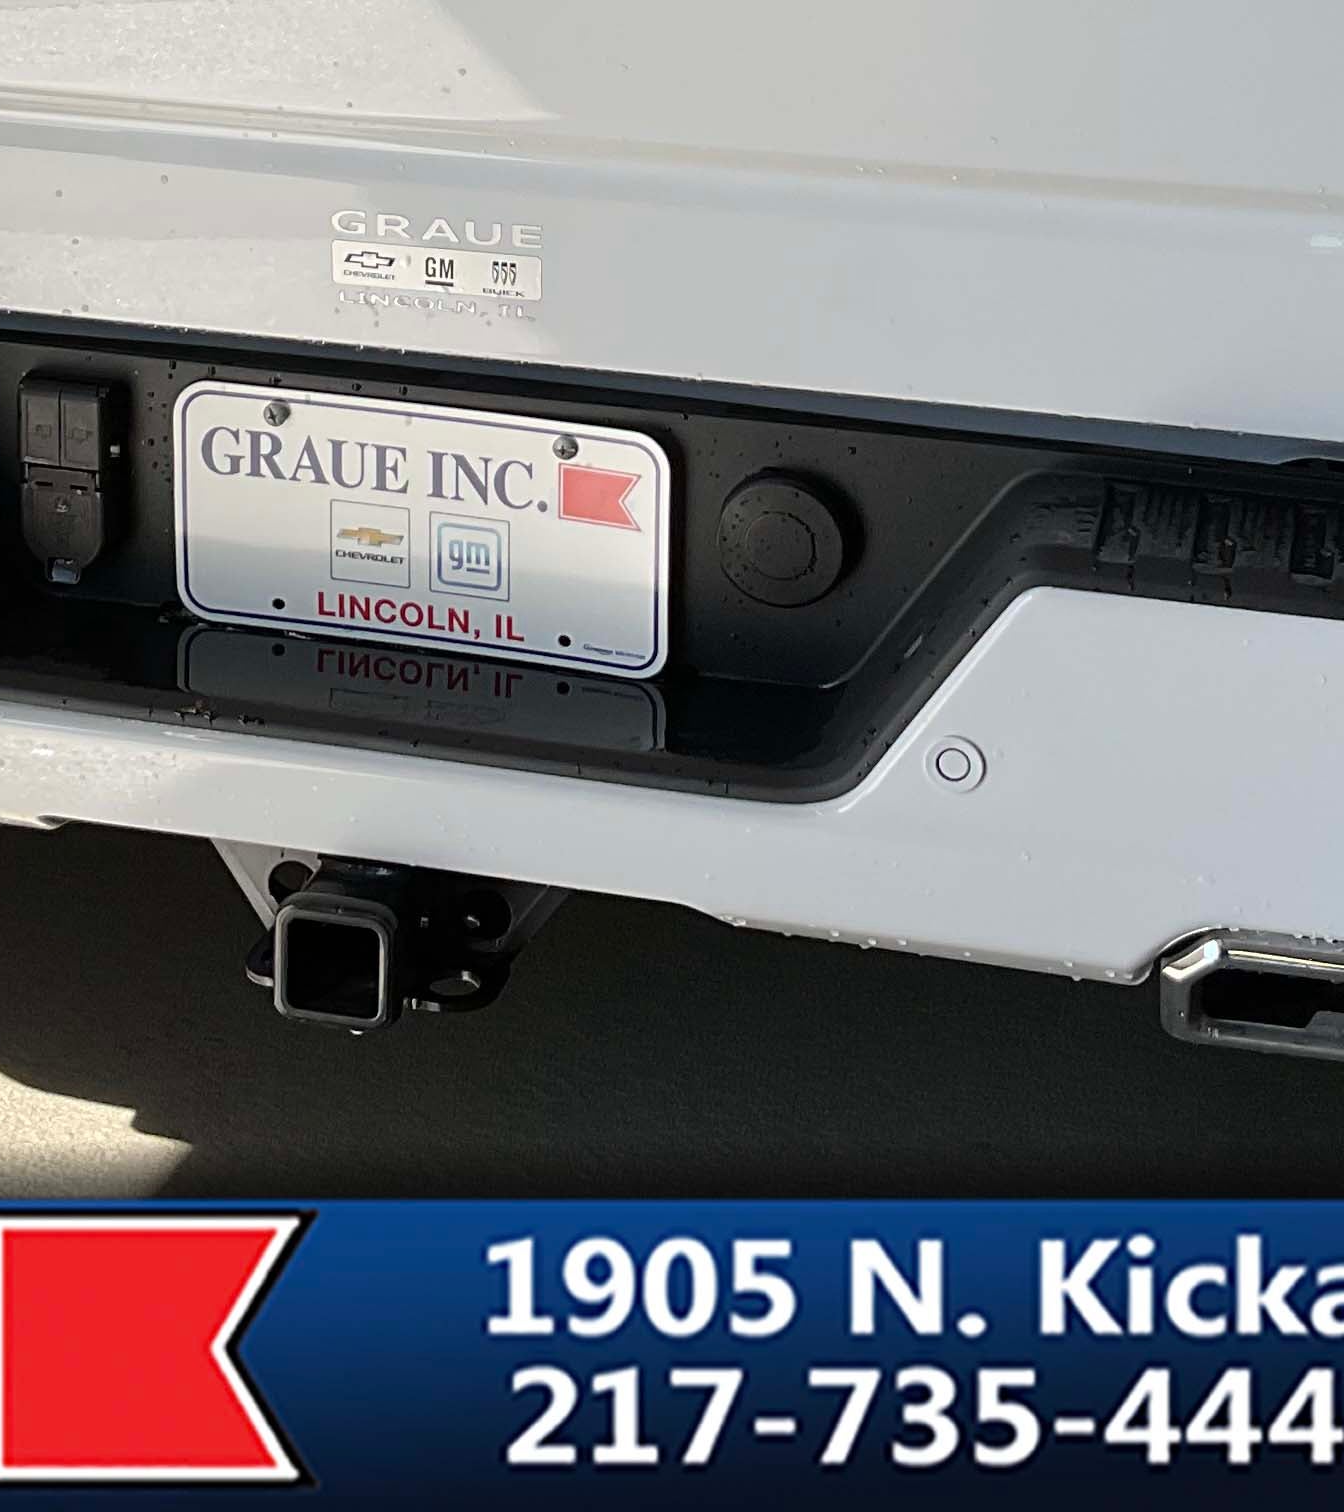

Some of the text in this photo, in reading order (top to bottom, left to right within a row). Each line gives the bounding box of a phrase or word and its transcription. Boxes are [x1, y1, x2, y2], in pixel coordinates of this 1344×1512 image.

[330, 209, 544, 249] GRAUE
[424, 256, 455, 280] GM
[200, 424, 549, 514] GRAUE INC.
[335, 549, 405, 565] CHEVROLET
[448, 539, 491, 571] gm
[317, 591, 525, 642] LINCOLN, IL
